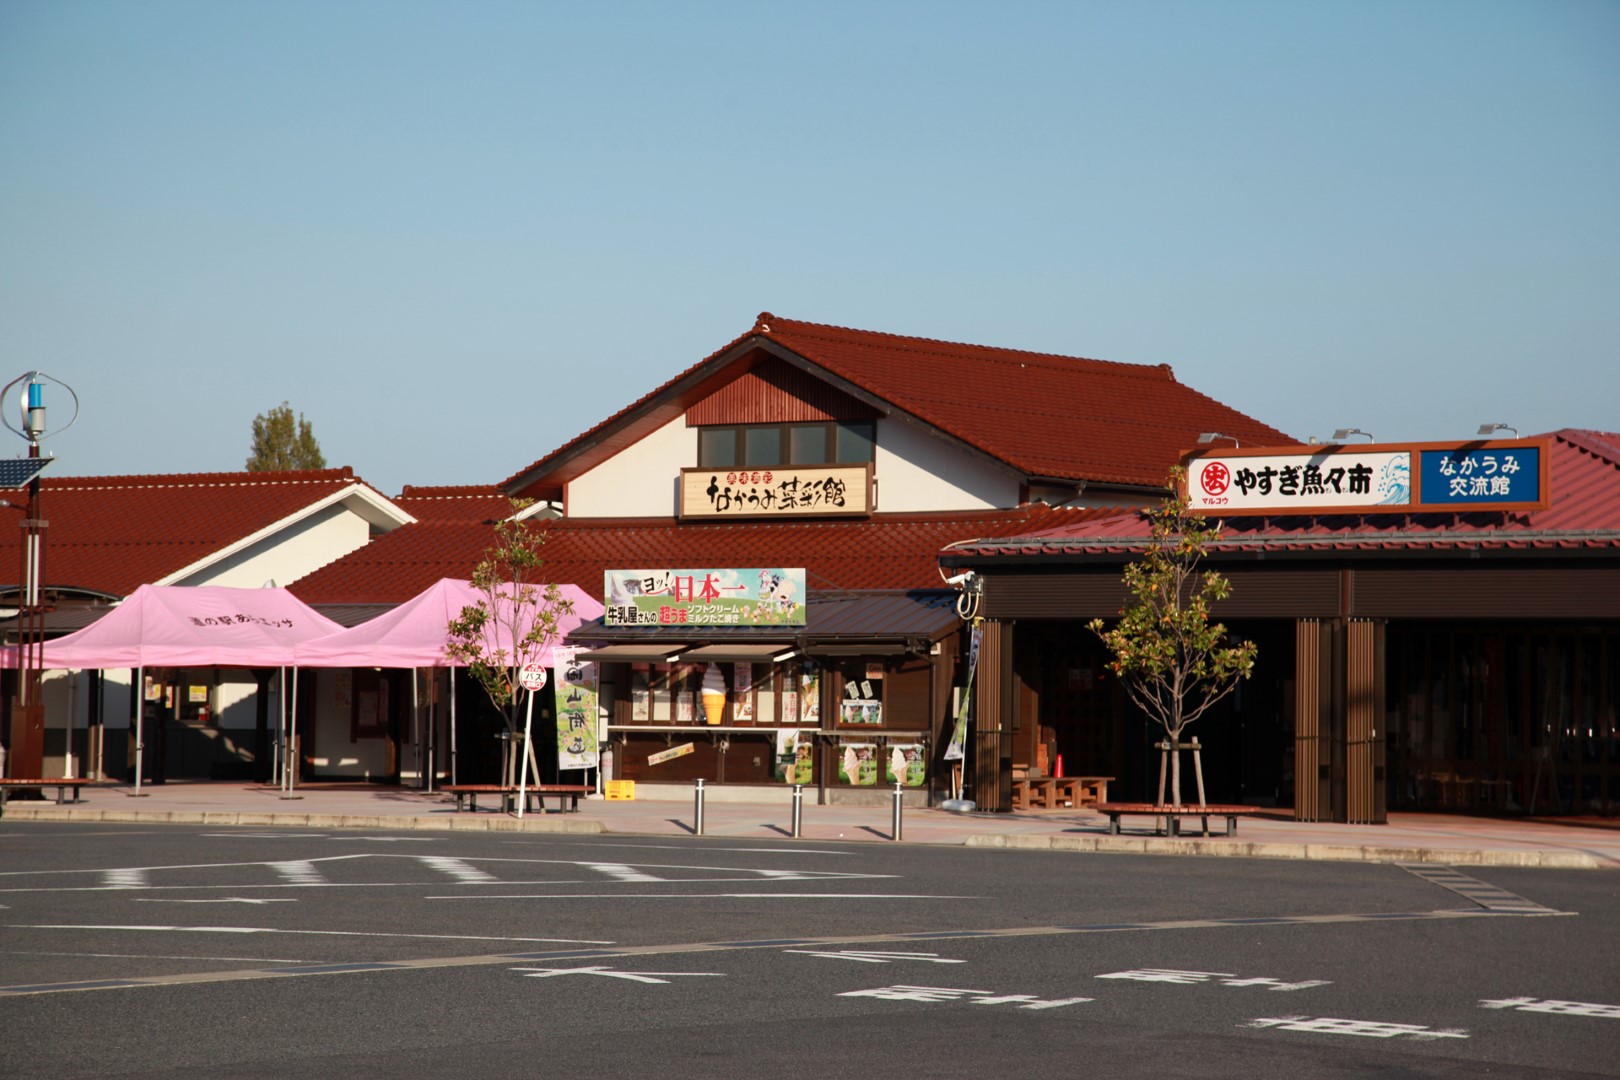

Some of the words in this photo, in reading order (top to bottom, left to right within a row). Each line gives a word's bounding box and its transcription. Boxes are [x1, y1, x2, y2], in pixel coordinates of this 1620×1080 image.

[1440, 456, 1520, 476] なかうみ
[1234, 463, 1373, 496] やすぎ魚々市
[1449, 475, 1510, 497] 交流館
[706, 476, 846, 512] なかうみ菜彩館
[1202, 497, 1228, 505] マルコウ
[674, 573, 746, 604] 日本一
[608, 605, 656, 624] 牛乳屋さんの
[659, 606, 687, 624] 超うま
[687, 604, 739, 614] ソフトクリーム
[525, 672, 542, 681] バス
